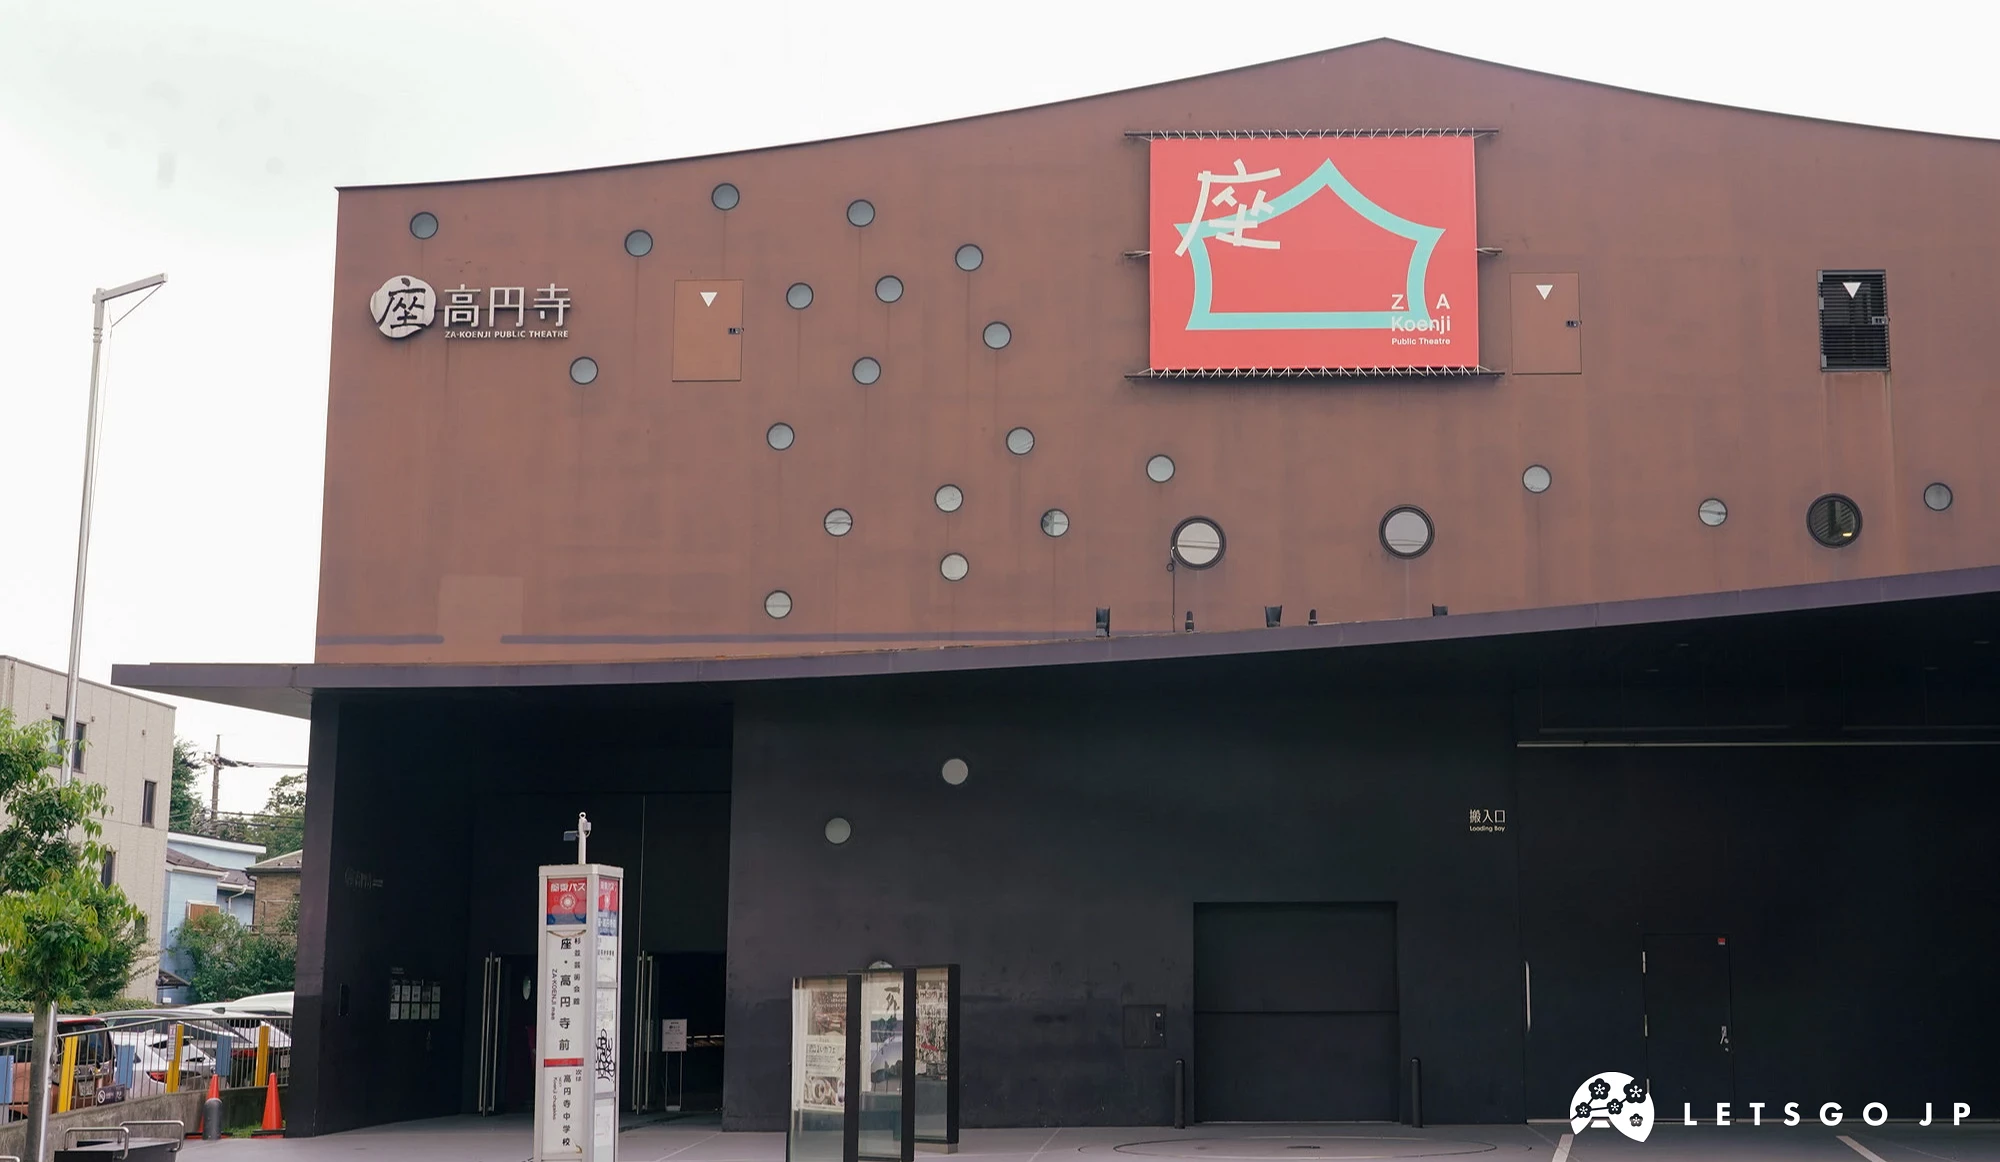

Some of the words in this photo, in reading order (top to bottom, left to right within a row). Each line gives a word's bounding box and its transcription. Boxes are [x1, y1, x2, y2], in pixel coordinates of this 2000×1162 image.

[1174, 158, 1281, 257] 座
[377, 277, 429, 330] 座
[443, 283, 571, 328] 高円寺
[1391, 315, 1451, 333] Koenji
[494, 330, 526, 339] PUBLIC
[528, 330, 569, 338] THEATRE
[1391, 337, 1416, 346] Public
[1418, 337, 1451, 346] Theatre
[1469, 809, 1506, 823] 搬入口
[562, 1074, 572, 1147] 高円寺中学校
